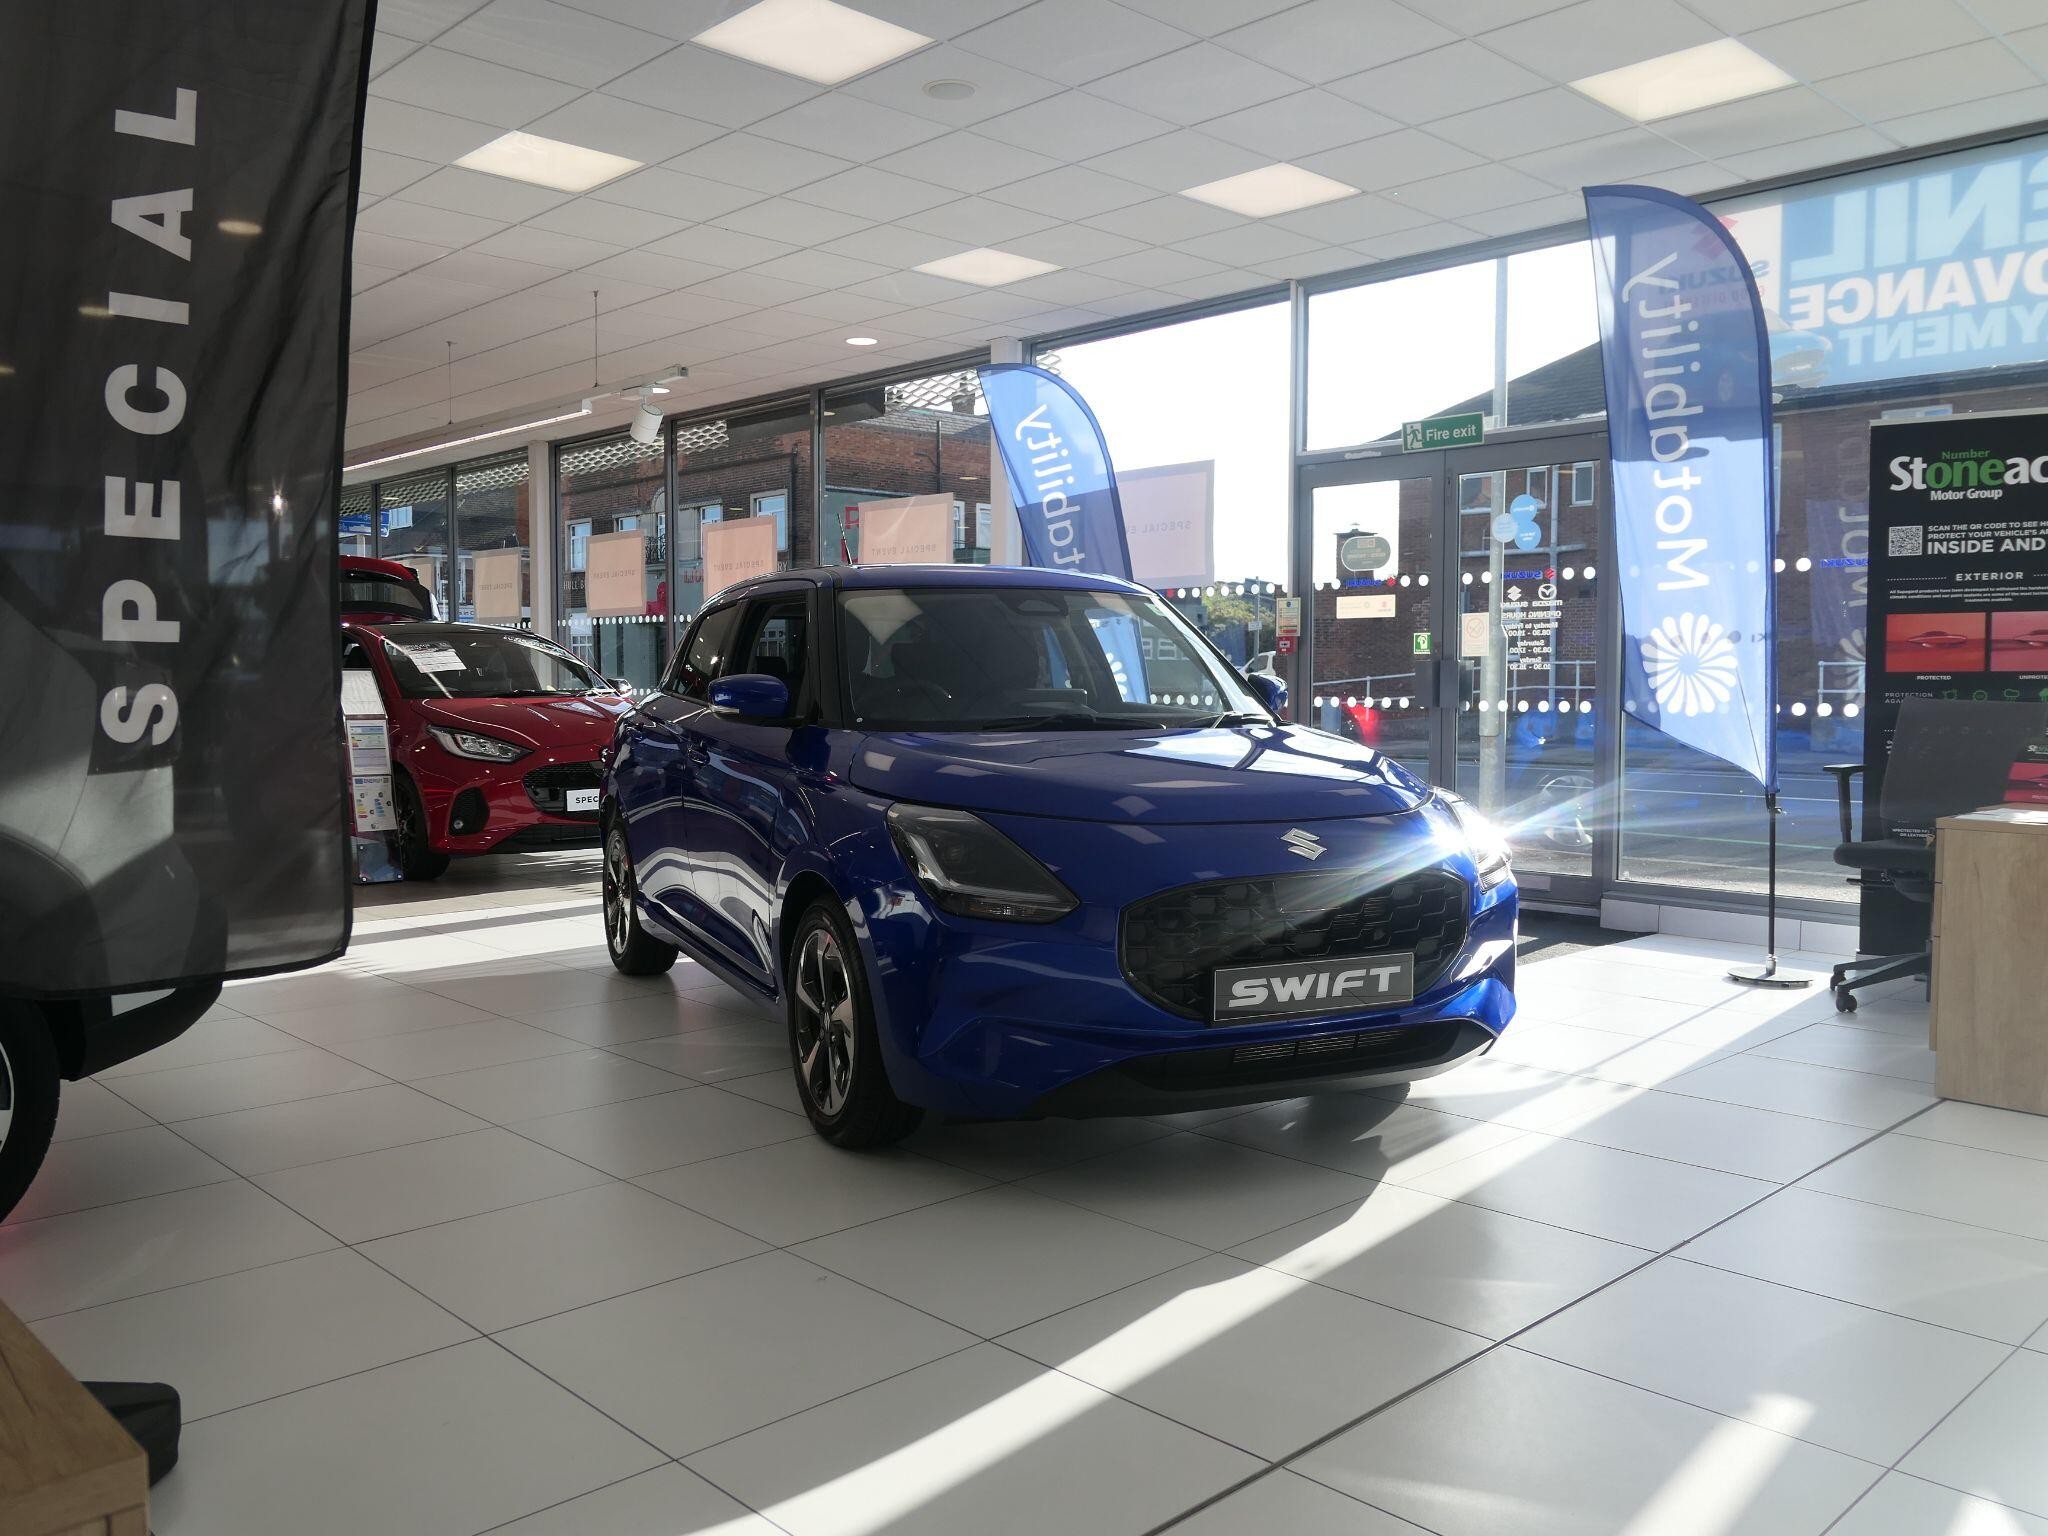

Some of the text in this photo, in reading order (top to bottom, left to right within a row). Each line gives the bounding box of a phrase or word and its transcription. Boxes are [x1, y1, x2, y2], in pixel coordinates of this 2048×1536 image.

[101, 88, 197, 746] SPECIAL
[1426, 424, 1477, 442] Fire exit
[1941, 449, 1991, 460] Number
[1930, 488, 2003, 501] Motor Group
[1994, 529, 2038, 537] VEHICLE'S
[1927, 537, 2047, 555] INSIDE AND
[1955, 571, 2024, 581] EXTERIOR
[575, 795, 599, 804] SPEC
[1228, 965, 1401, 1008] SWIFT
